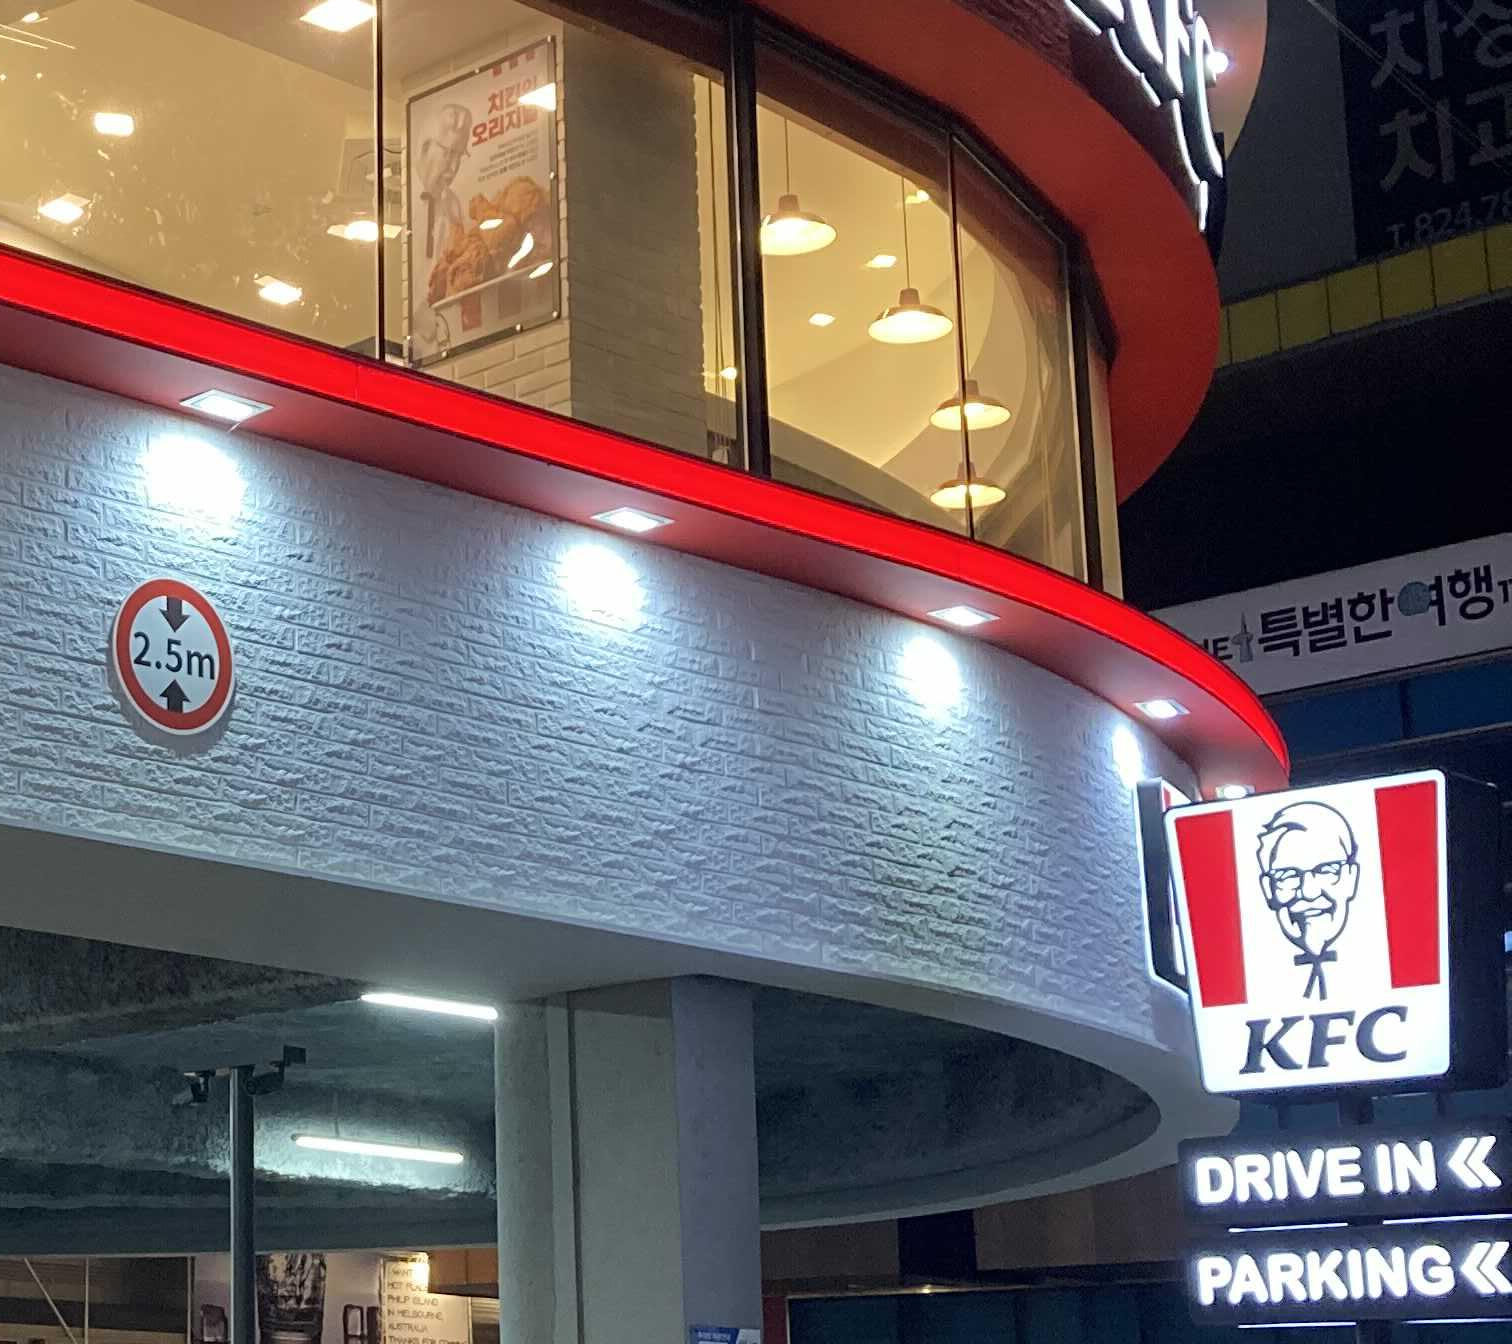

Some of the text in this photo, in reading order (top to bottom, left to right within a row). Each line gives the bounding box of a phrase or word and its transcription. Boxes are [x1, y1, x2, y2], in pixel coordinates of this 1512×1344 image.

[133, 630, 216, 681] 2.5m
[1239, 1006, 1409, 1077] KFC
[1193, 1139, 1439, 1208] DRIVE IN
[1195, 1243, 1456, 1307] PARKING
